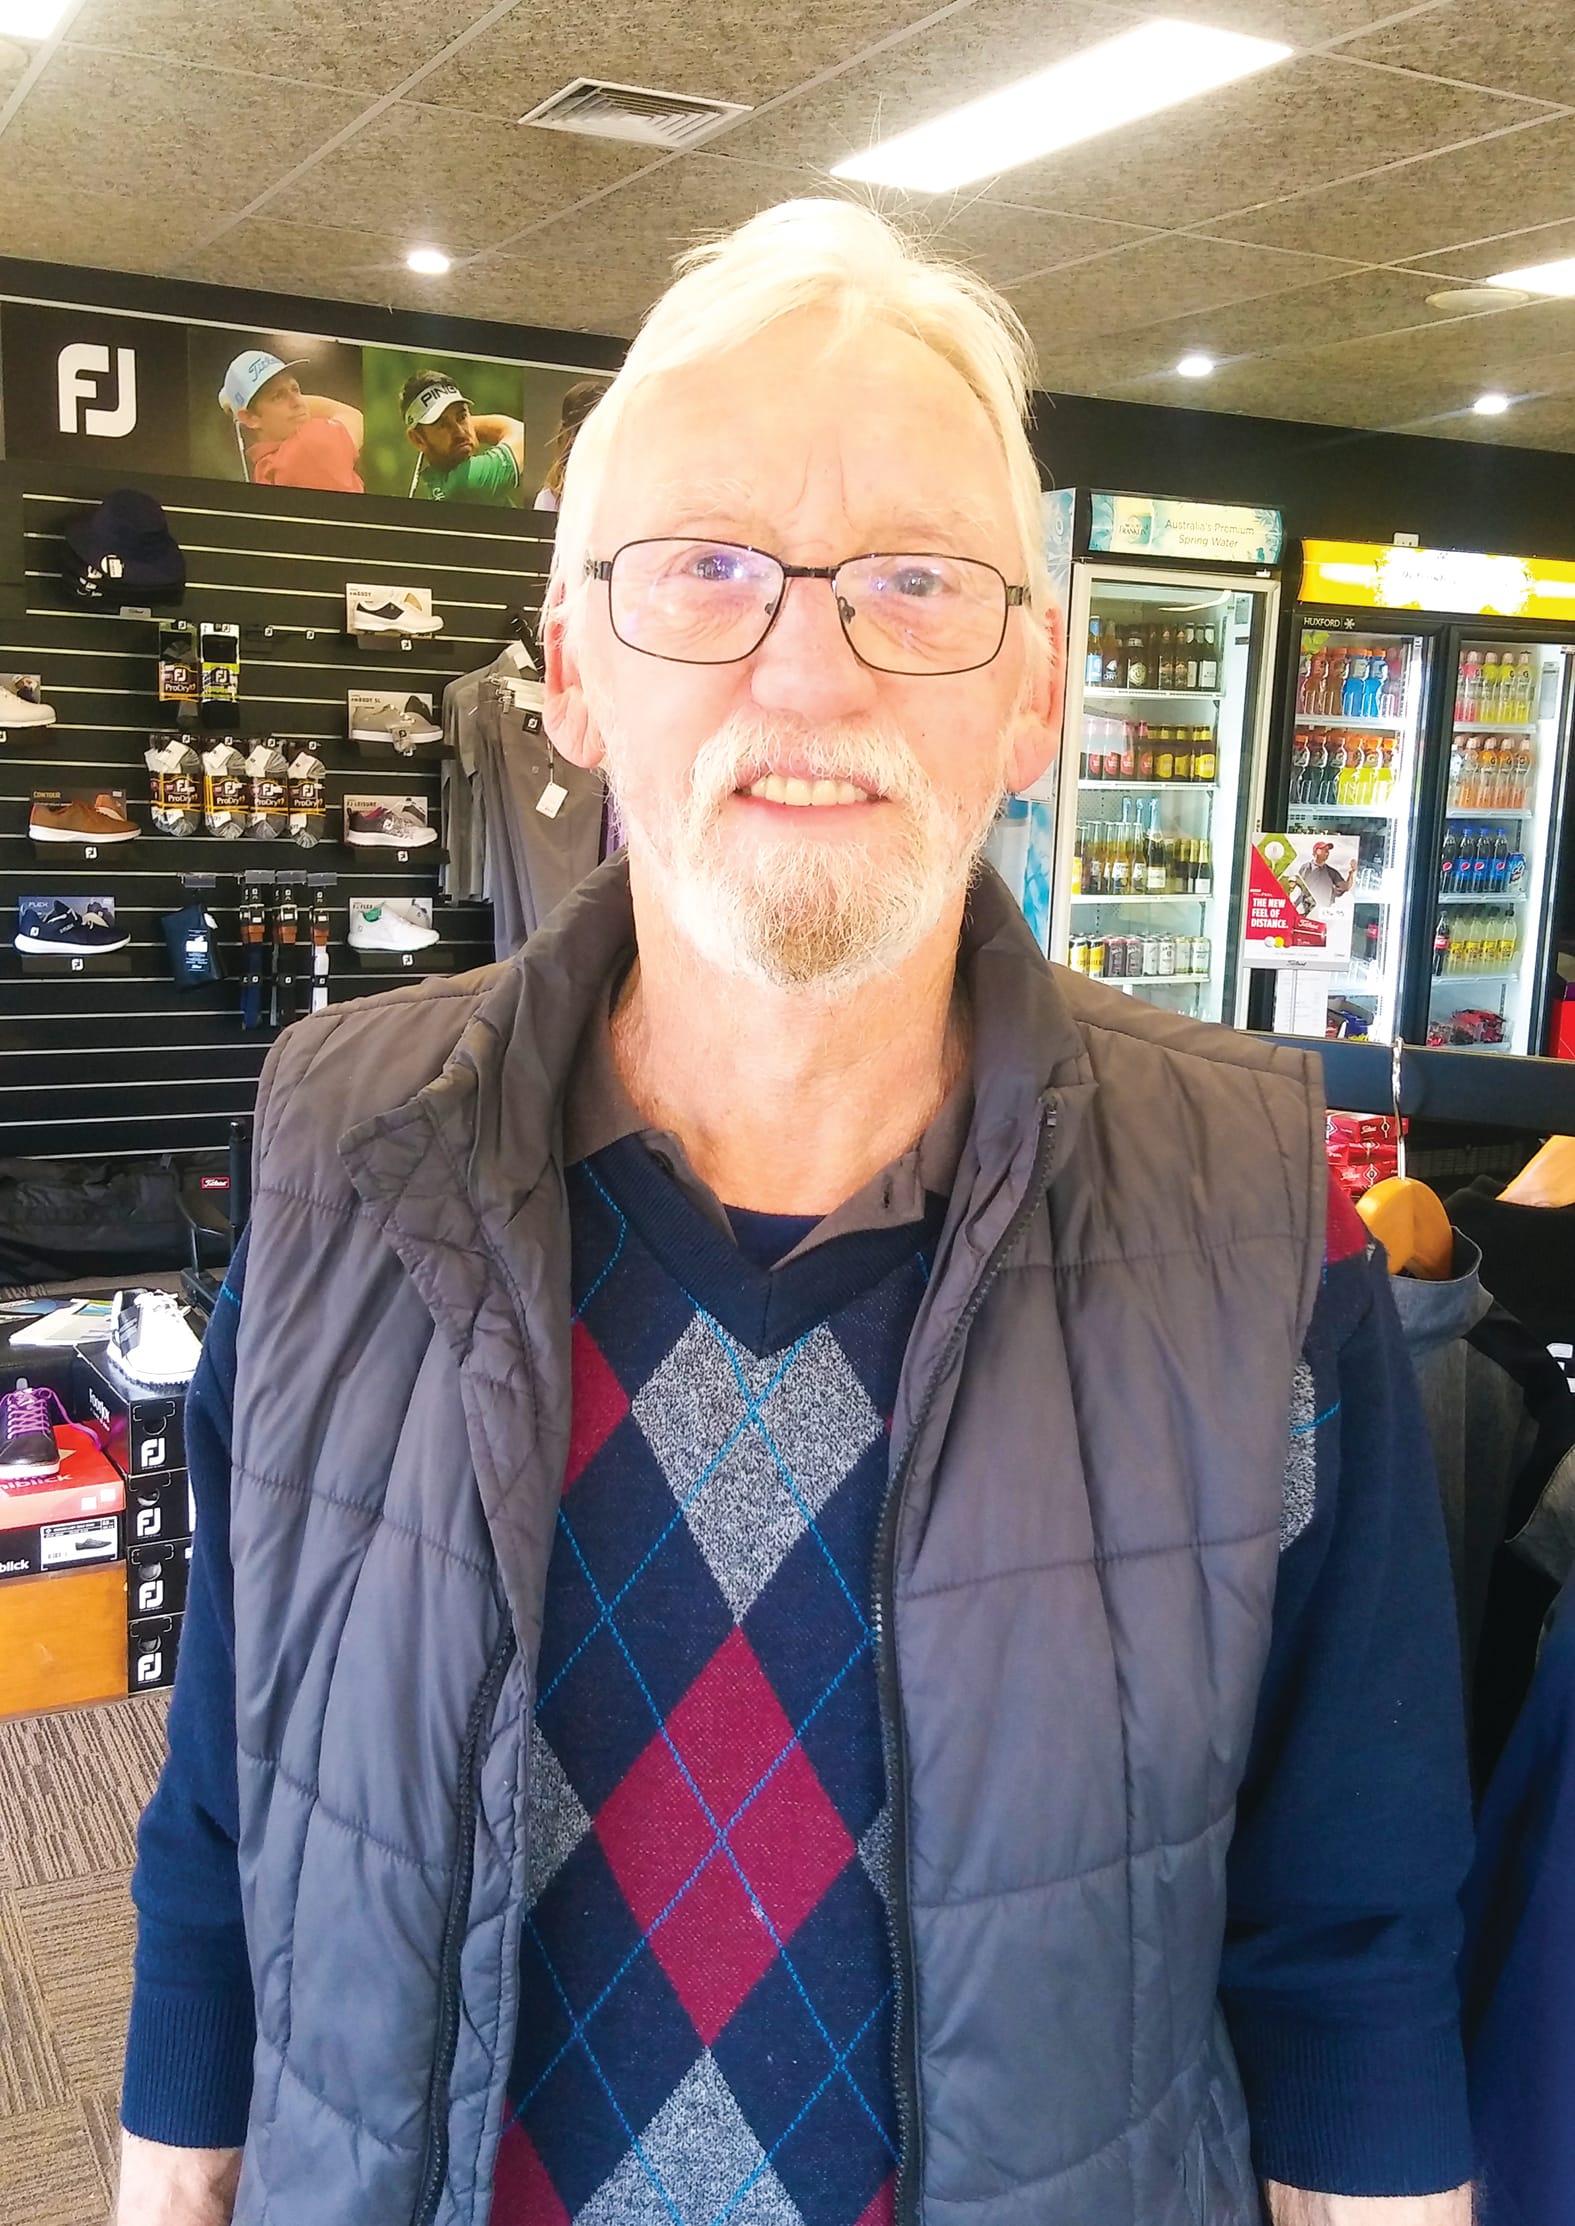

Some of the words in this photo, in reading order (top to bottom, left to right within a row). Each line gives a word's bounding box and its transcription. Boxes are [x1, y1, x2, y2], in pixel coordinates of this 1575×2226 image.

[58, 343, 137, 438] FJ
[420, 383, 458, 409] PING
[1165, 519, 1212, 532] Australia's
[1214, 522, 1255, 536] Premium
[1179, 534, 1208, 546] Spring
[1212, 537, 1239, 548] Water
[1303, 617, 1341, 628] HUXFORD
[174, 668, 187, 682] FJ
[216, 670, 228, 683] FJ
[165, 683, 190, 695] ProDry
[176, 780, 188, 793] FJ
[225, 781, 236, 794] FJ
[262, 784, 274, 796] FJ
[302, 784, 314, 797] FJ
[85, 847, 98, 859] FJ
[1253, 898, 1267, 908] THE
[1268, 898, 1286, 909] NEW
[1252, 908, 1269, 918] FEEL
[1269, 909, 1281, 918] OF
[1250, 918, 1289, 929] DISTANCE.
[71, 958, 84, 971] FJ
[141, 1437, 166, 1468] FJ
[137, 1507, 161, 1537] FJ
[139, 1579, 164, 1611] FJ
[137, 1652, 162, 1682] FJ
